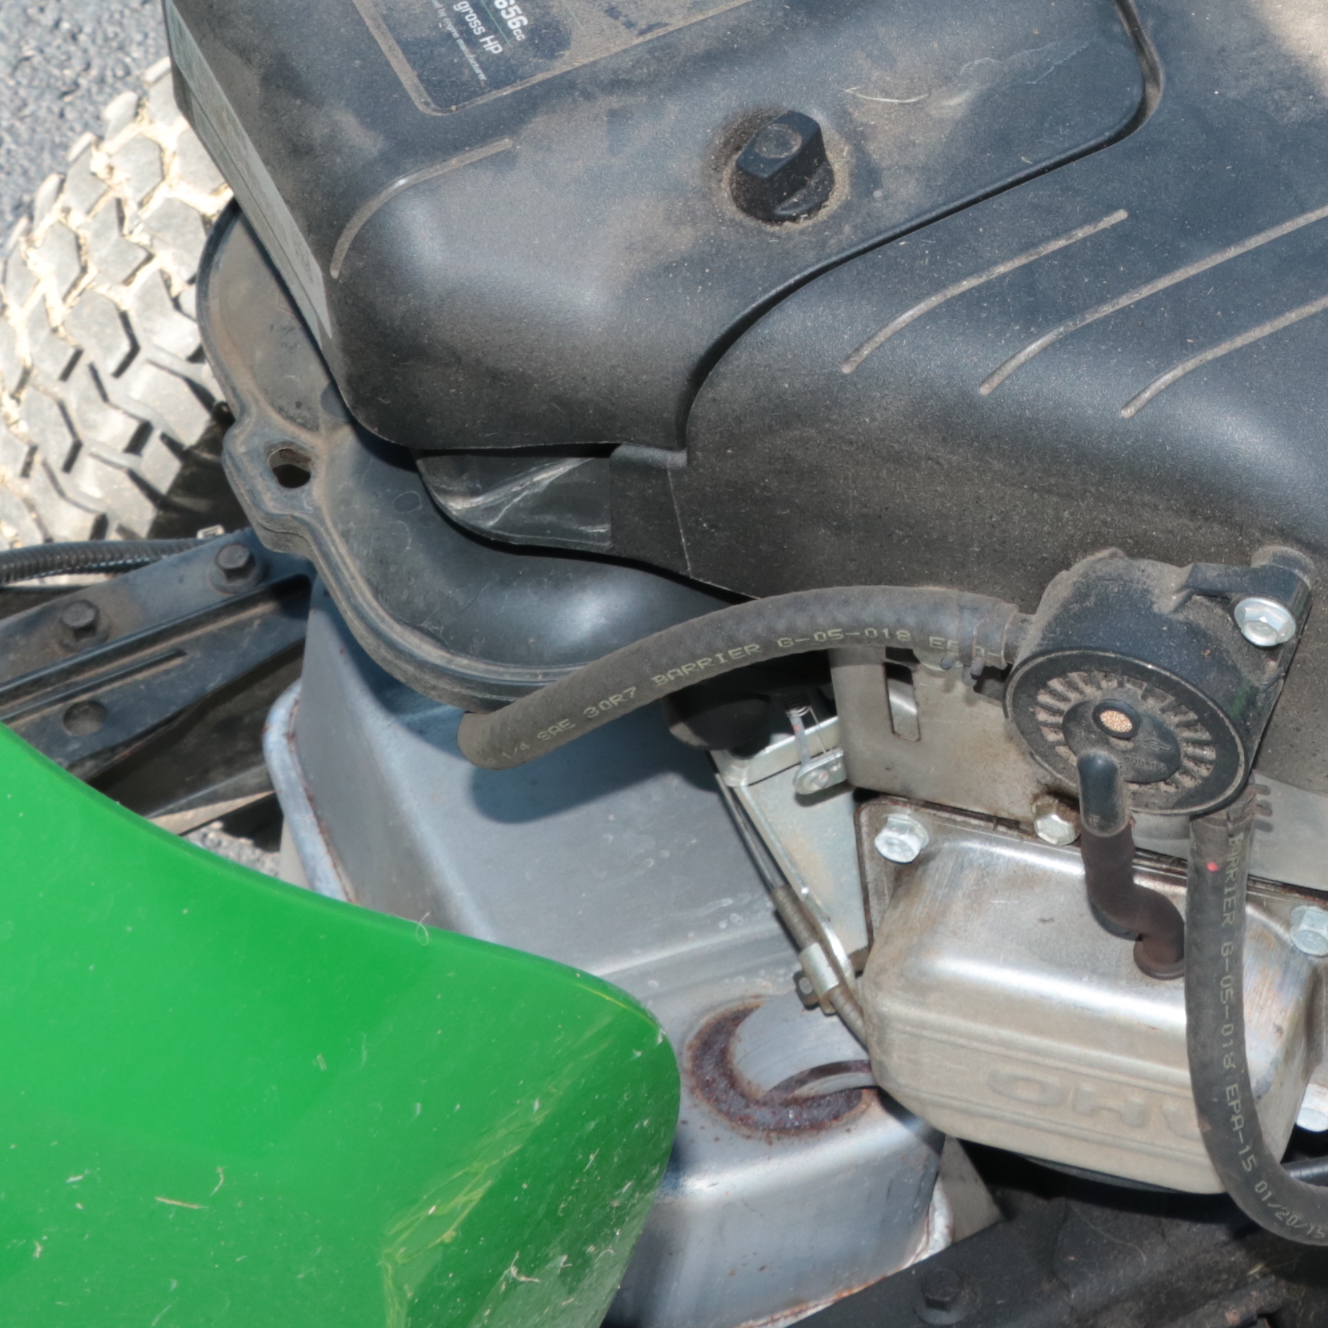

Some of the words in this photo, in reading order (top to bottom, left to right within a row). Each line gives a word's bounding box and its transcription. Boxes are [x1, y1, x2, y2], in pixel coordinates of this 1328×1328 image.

[435, 8, 448, 18] by
[439, 16, 462, 39] engine
[450, 0, 489, 37] gross
[478, 34, 504, 56] HP
[536, 718, 577, 742] SAE
[583, 685, 637, 719] 30R7
[650, 643, 763, 687] BARRIER
[776, 627, 912, 649] G-05-018
[1221, 832, 1244, 926] BARRIER
[1219, 941, 1237, 1069] G-05-018
[1224, 1082, 1257, 1172] EPA-15
[1252, 1179, 1324, 1240] 01/20/15
